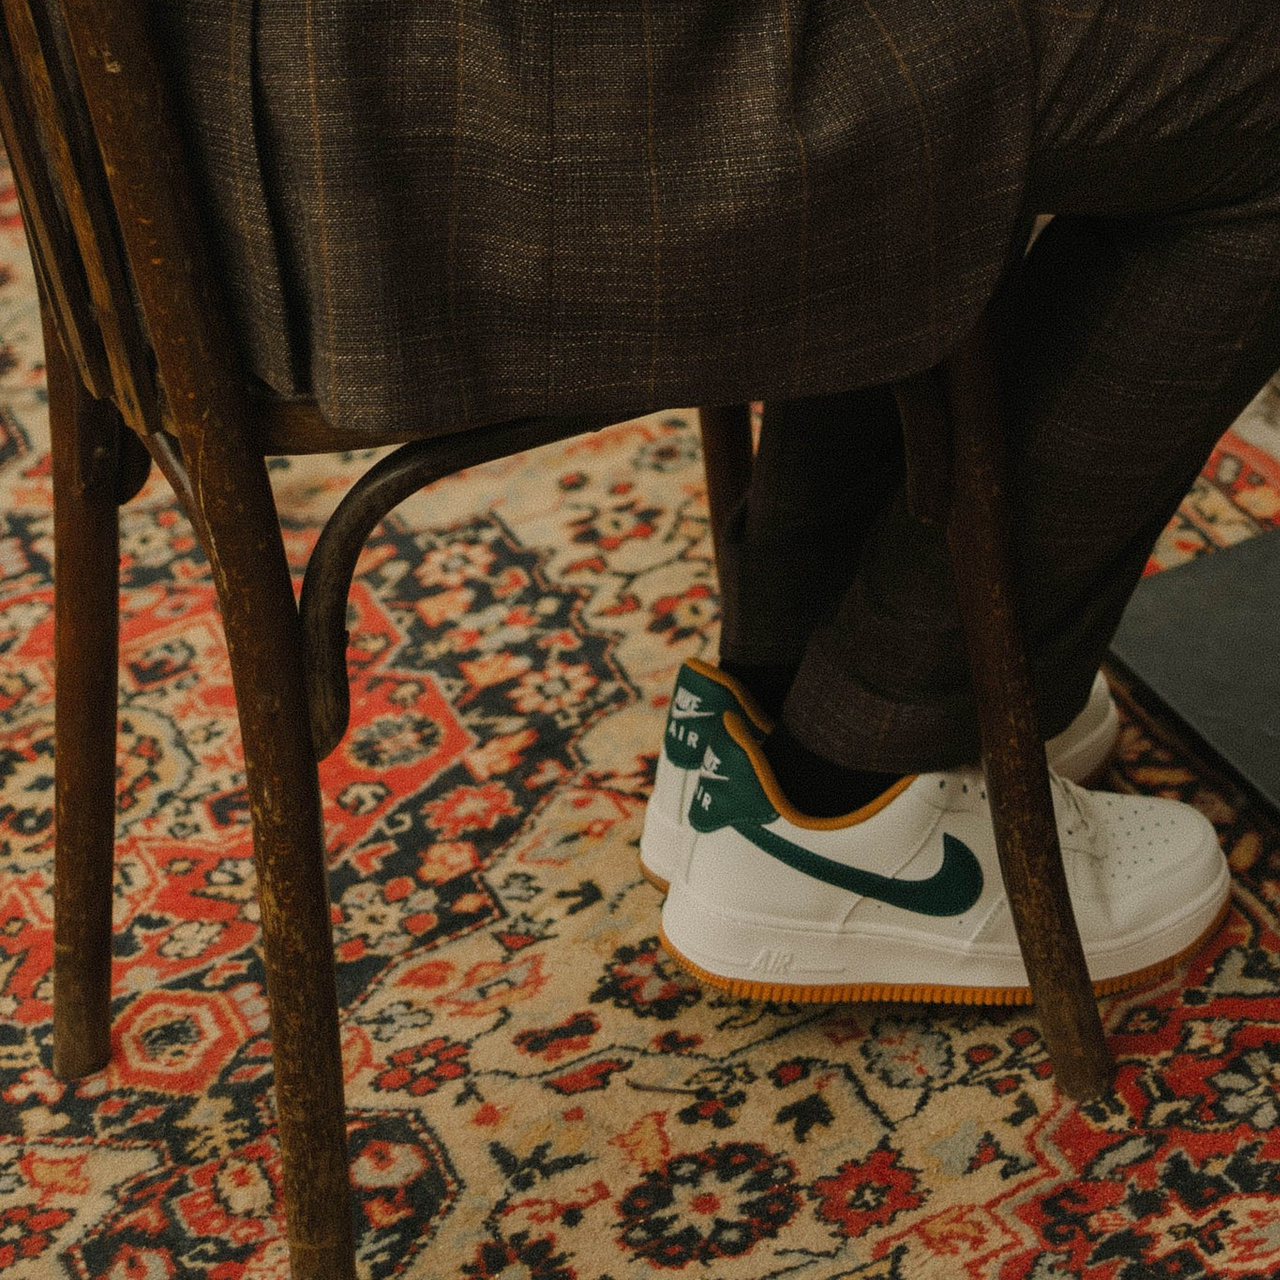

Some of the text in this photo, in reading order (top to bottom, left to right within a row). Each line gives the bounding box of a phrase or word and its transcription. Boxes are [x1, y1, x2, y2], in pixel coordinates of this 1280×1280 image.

[668, 720, 700, 749] AIR
[697, 785, 713, 812] IR
[749, 945, 795, 975] AIR
